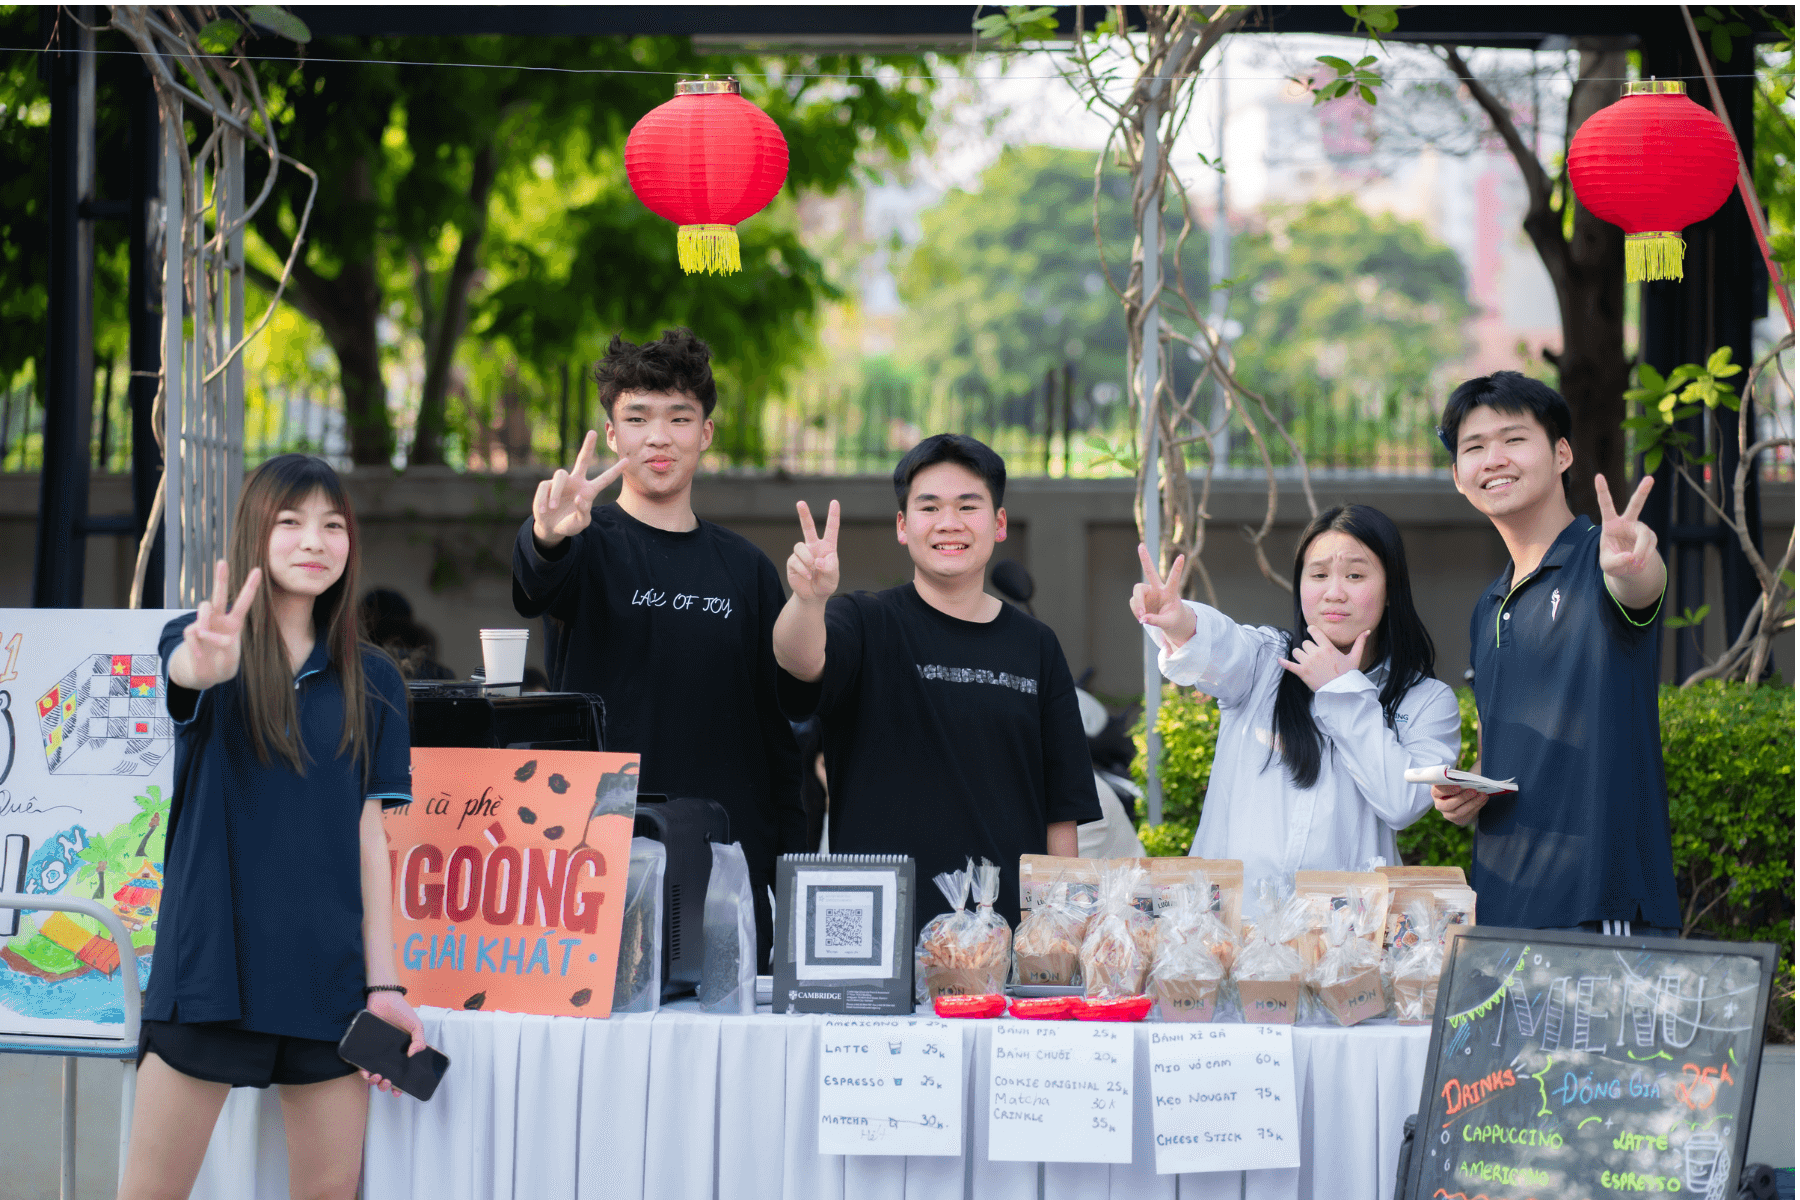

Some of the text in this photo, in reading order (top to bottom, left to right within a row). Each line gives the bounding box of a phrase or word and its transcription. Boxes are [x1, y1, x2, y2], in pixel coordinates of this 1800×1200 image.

[672, 593, 700, 610] OF
[702, 597, 733, 619] JOY
[425, 791, 452, 816] cà
[402, 924, 582, 977] GIẢI KHÁT
[797, 991, 842, 1000] CAMBRIDGE
[1491, 974, 1707, 1053] MENU
[825, 1043, 869, 1054] LATTE
[1205, 1059, 1232, 1070] CAM
[823, 1075, 885, 1088] ESPRESSO
[994, 1075, 1040, 1089] COOKIE
[1044, 1079, 1100, 1091] ORIGINAL
[994, 1092, 1050, 1106] Matcha
[1188, 1091, 1238, 1104] NOUGAT
[1441, 1067, 1517, 1116] DRINKS
[821, 1114, 869, 1127] MATCHA
[993, 1107, 1044, 1123] CRINKLE
[1156, 1133, 1199, 1147] CHEESE
[1203, 1131, 1243, 1143] STICK
[1462, 1123, 1669, 1151] CAPPUCCINO LATTE
